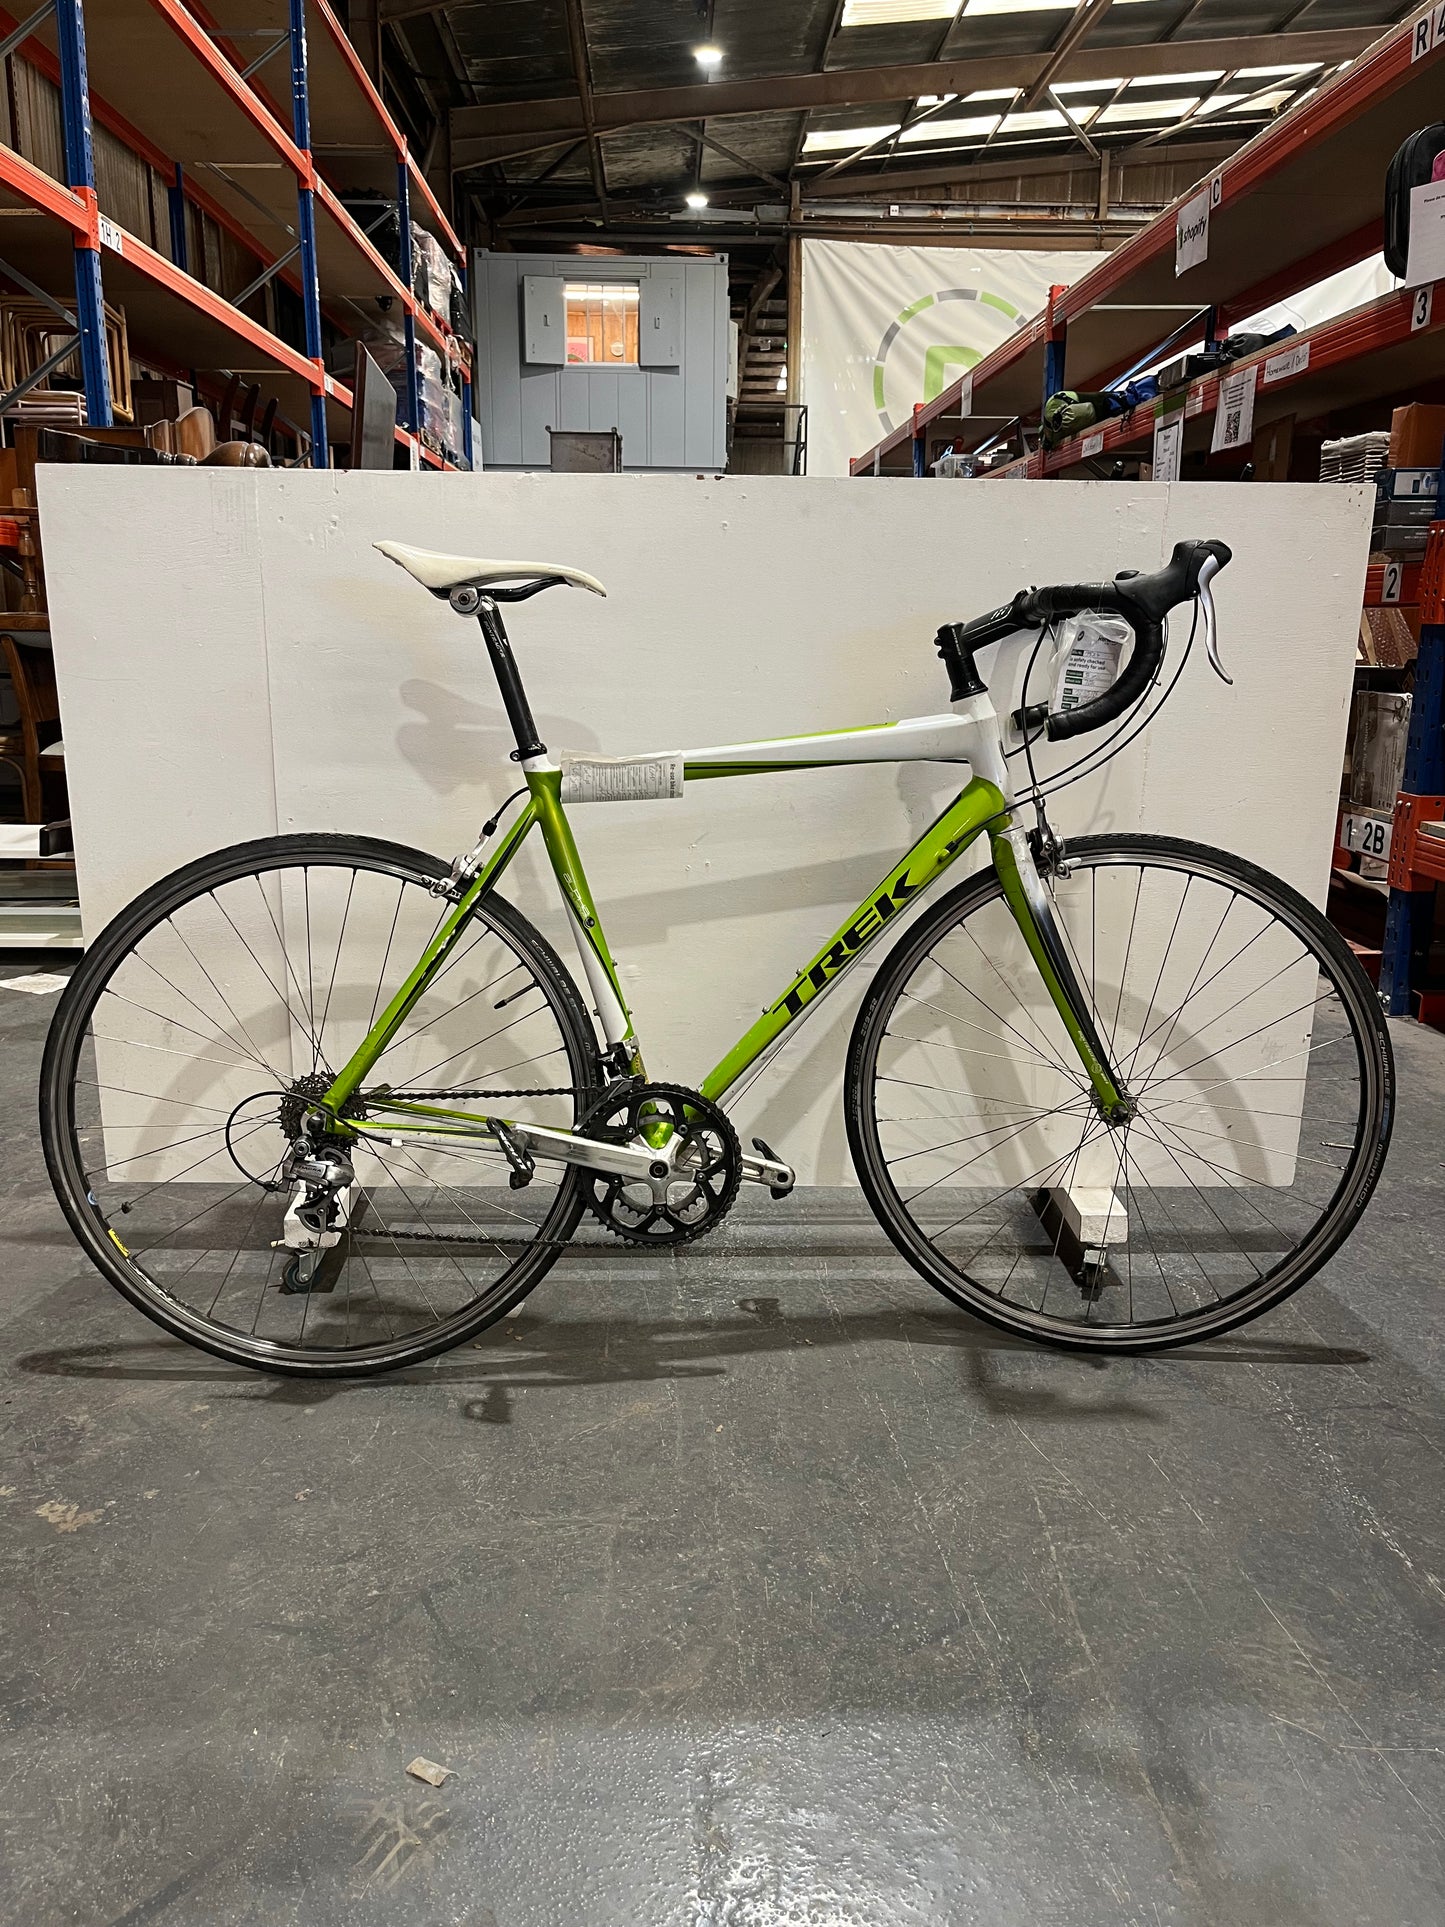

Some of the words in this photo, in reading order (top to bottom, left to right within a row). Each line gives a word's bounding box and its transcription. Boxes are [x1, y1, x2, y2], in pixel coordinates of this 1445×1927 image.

[1415, 18, 1428, 56] R
[1213, 178, 1220, 204] C
[1183, 215, 1207, 243] shopify
[1416, 291, 1428, 325] 3
[1386, 567, 1398, 599] 2
[1362, 821, 1385, 854] 2B
[772, 868, 919, 1016] TREK
[1377, 1031, 1390, 1095] SCHWALBE
[1355, 1143, 1383, 1208] MARATHON
